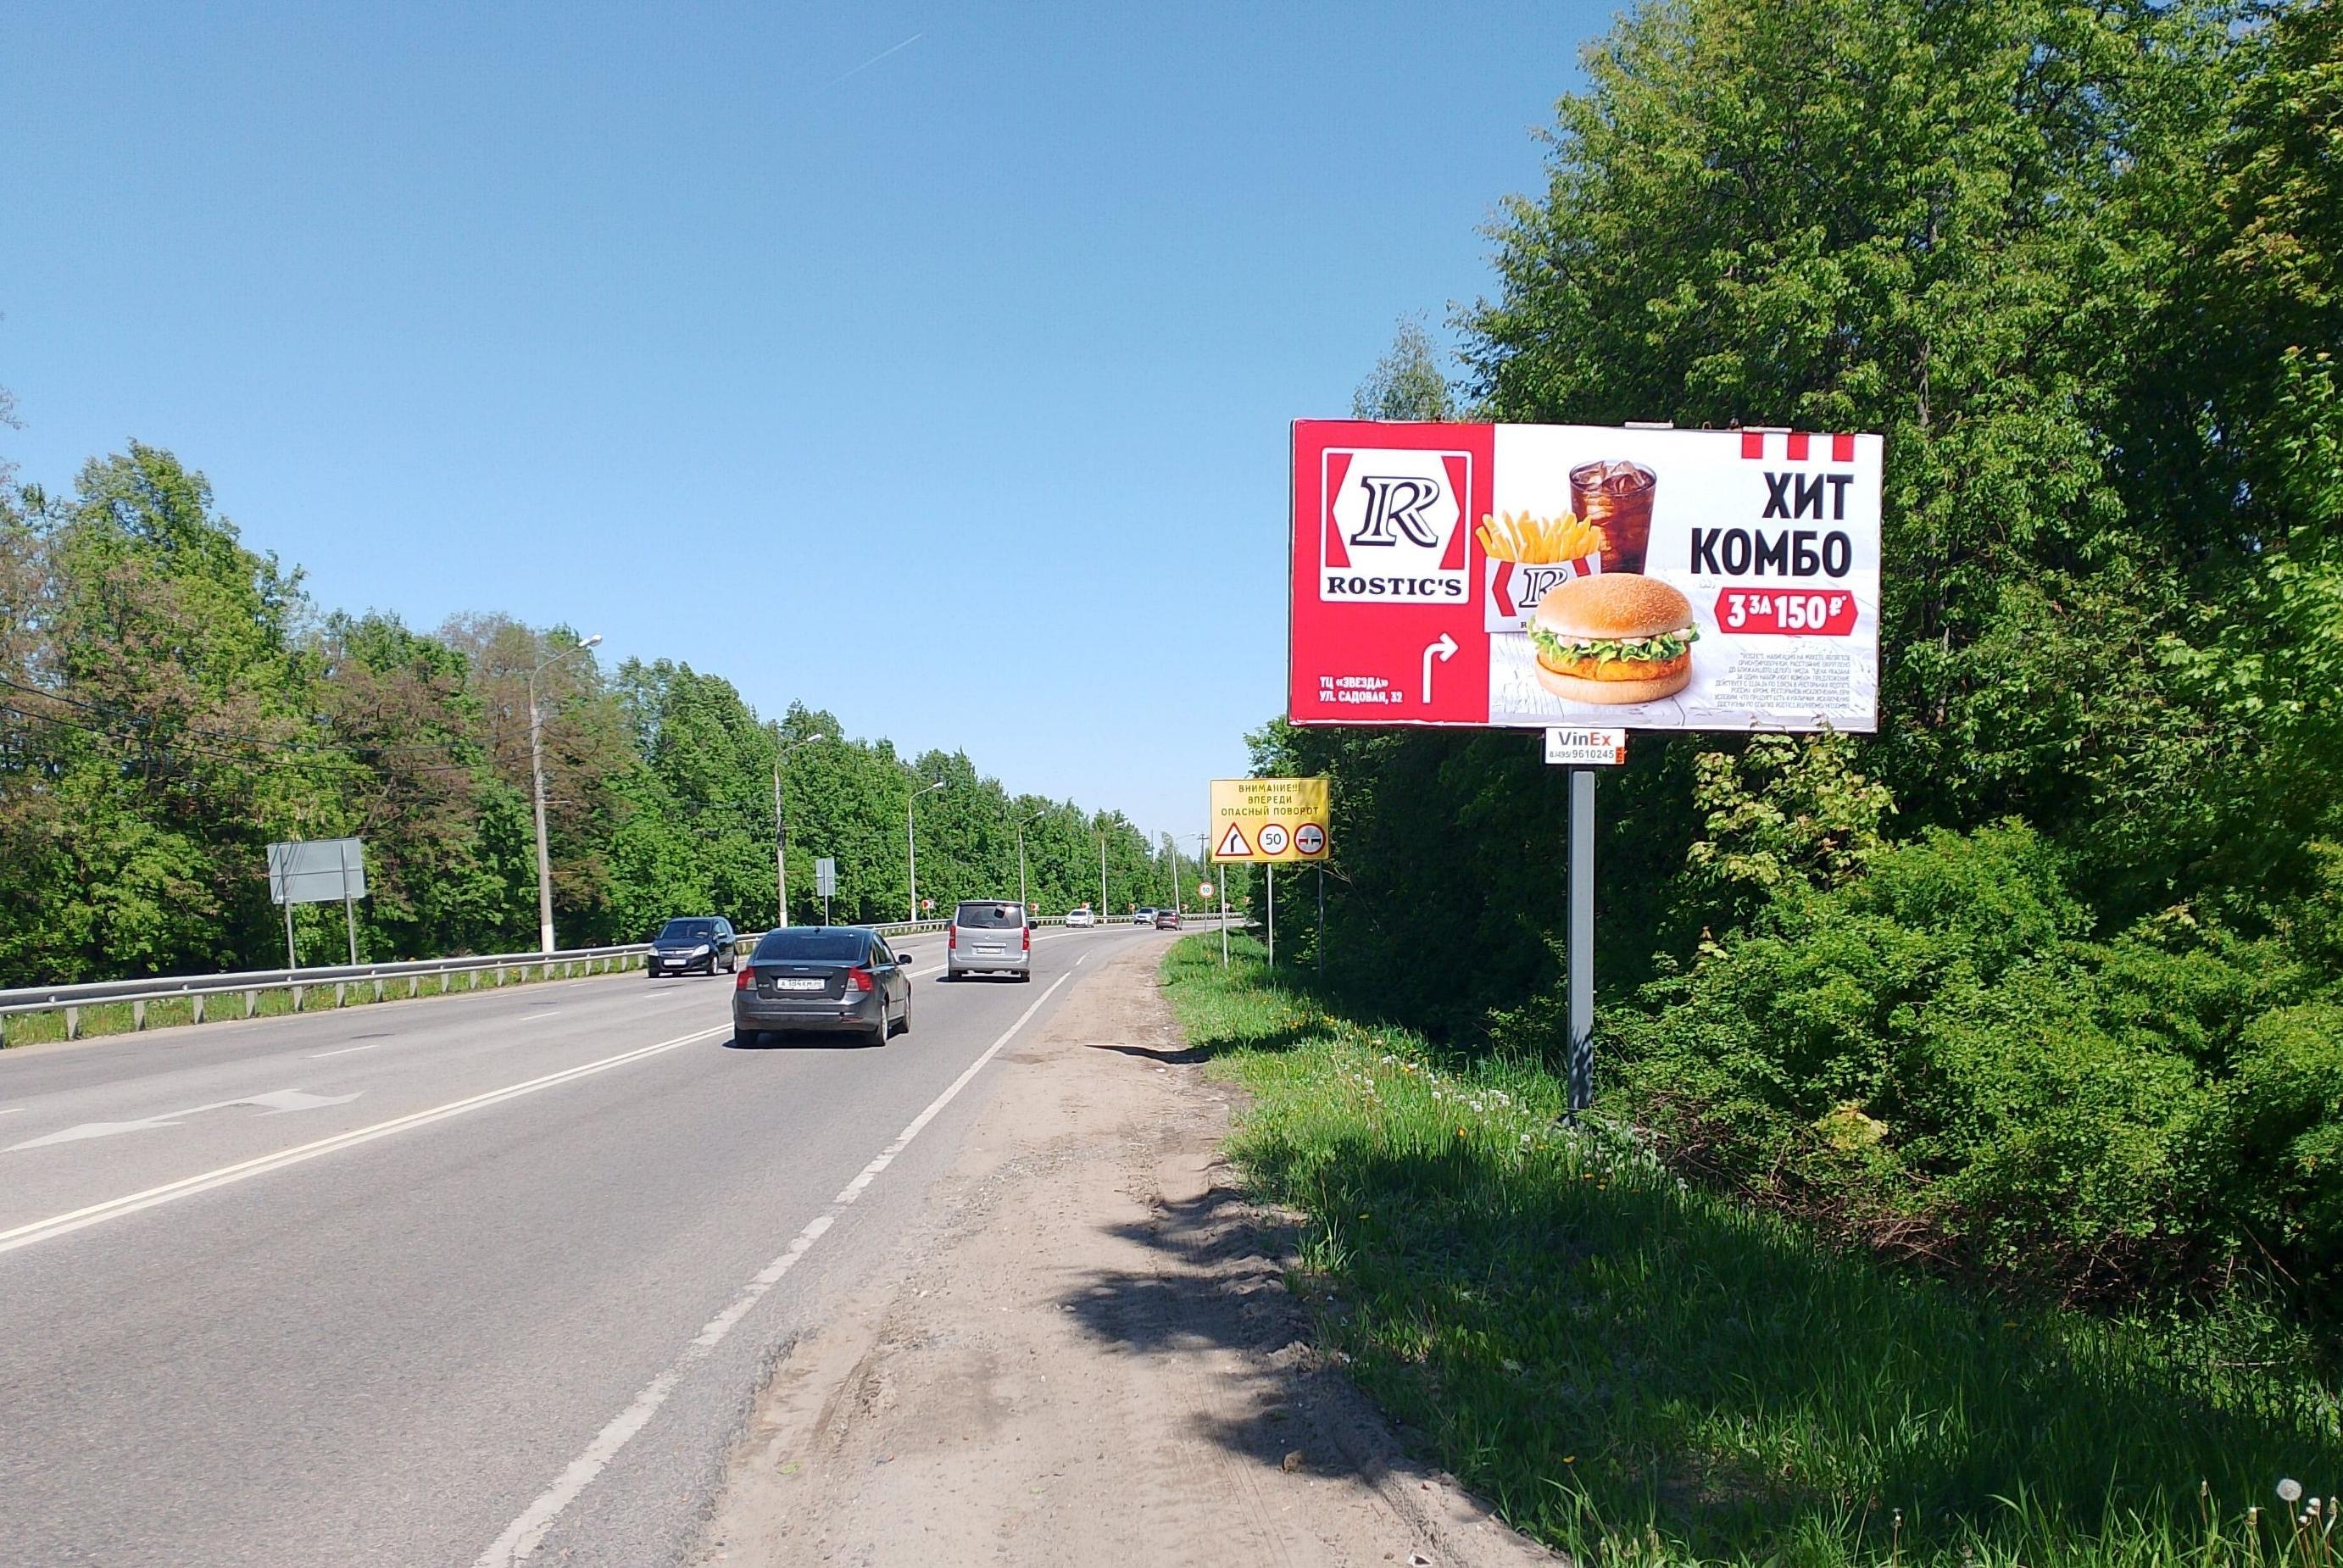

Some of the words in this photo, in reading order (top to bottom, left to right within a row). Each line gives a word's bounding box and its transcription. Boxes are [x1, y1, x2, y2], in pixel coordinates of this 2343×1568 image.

[1762, 472, 1854, 520] ХИТ
[1350, 475, 1440, 548] R
[1691, 527, 1852, 578] КОМБО
[1327, 576, 1462, 597] ROSTIC'S
[1727, 594, 1746, 627] 3
[1320, 676, 1333, 689] ТЦ
[1335, 676, 1389, 690] «ЗВЕЗДА»
[1320, 691, 1336, 702] УЛ.
[1338, 691, 1389, 705] САДОВАЯ,
[1391, 691, 1404, 703] 32
[1558, 731, 1611, 746] VinEx
[1238, 783, 1301, 792] ВНИМАНИЕ!!!
[1248, 796, 1292, 804] ВПЕРЕДИ
[1221, 806, 1270, 816] ОПАСНЫЙ
[1273, 807, 1319, 815] ПОВОРОТ
[1266, 833, 1282, 846] 50
